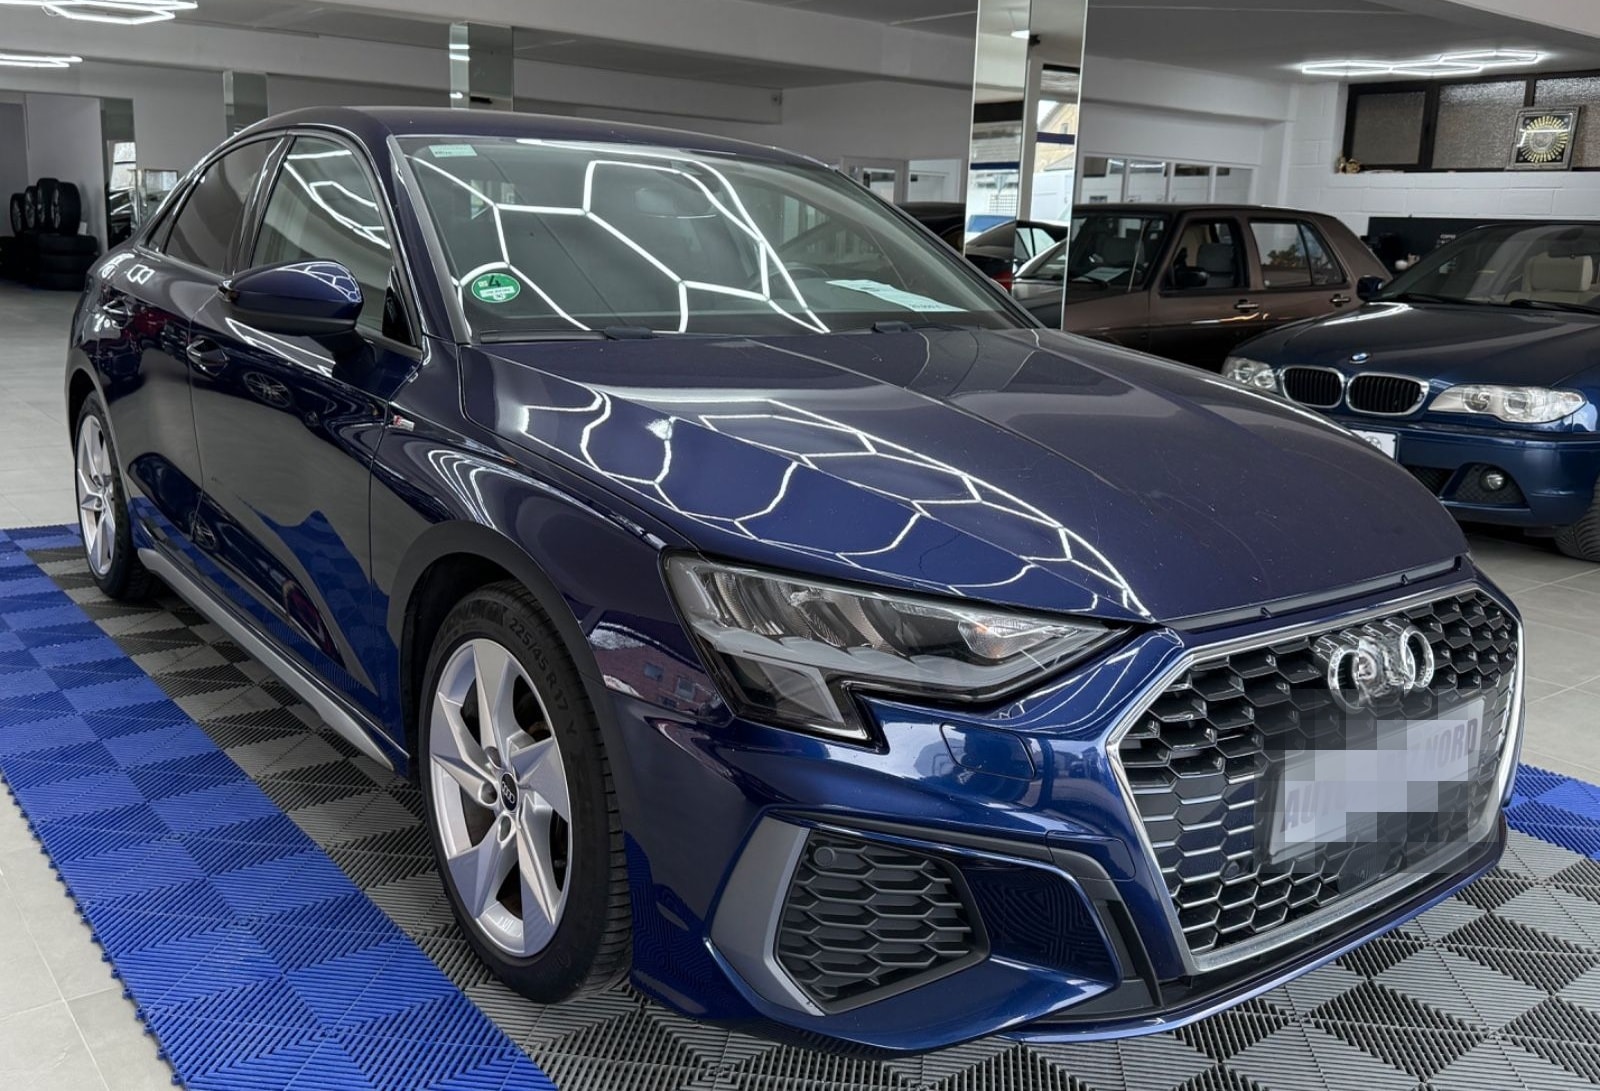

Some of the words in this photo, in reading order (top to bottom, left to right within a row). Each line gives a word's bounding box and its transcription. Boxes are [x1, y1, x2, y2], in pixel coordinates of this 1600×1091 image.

[488, 275, 501, 287] 4
[509, 617, 549, 671] 225/45
[545, 673, 557, 688] R
[555, 689, 569, 710] 17
[1424, 717, 1479, 771] NORD
